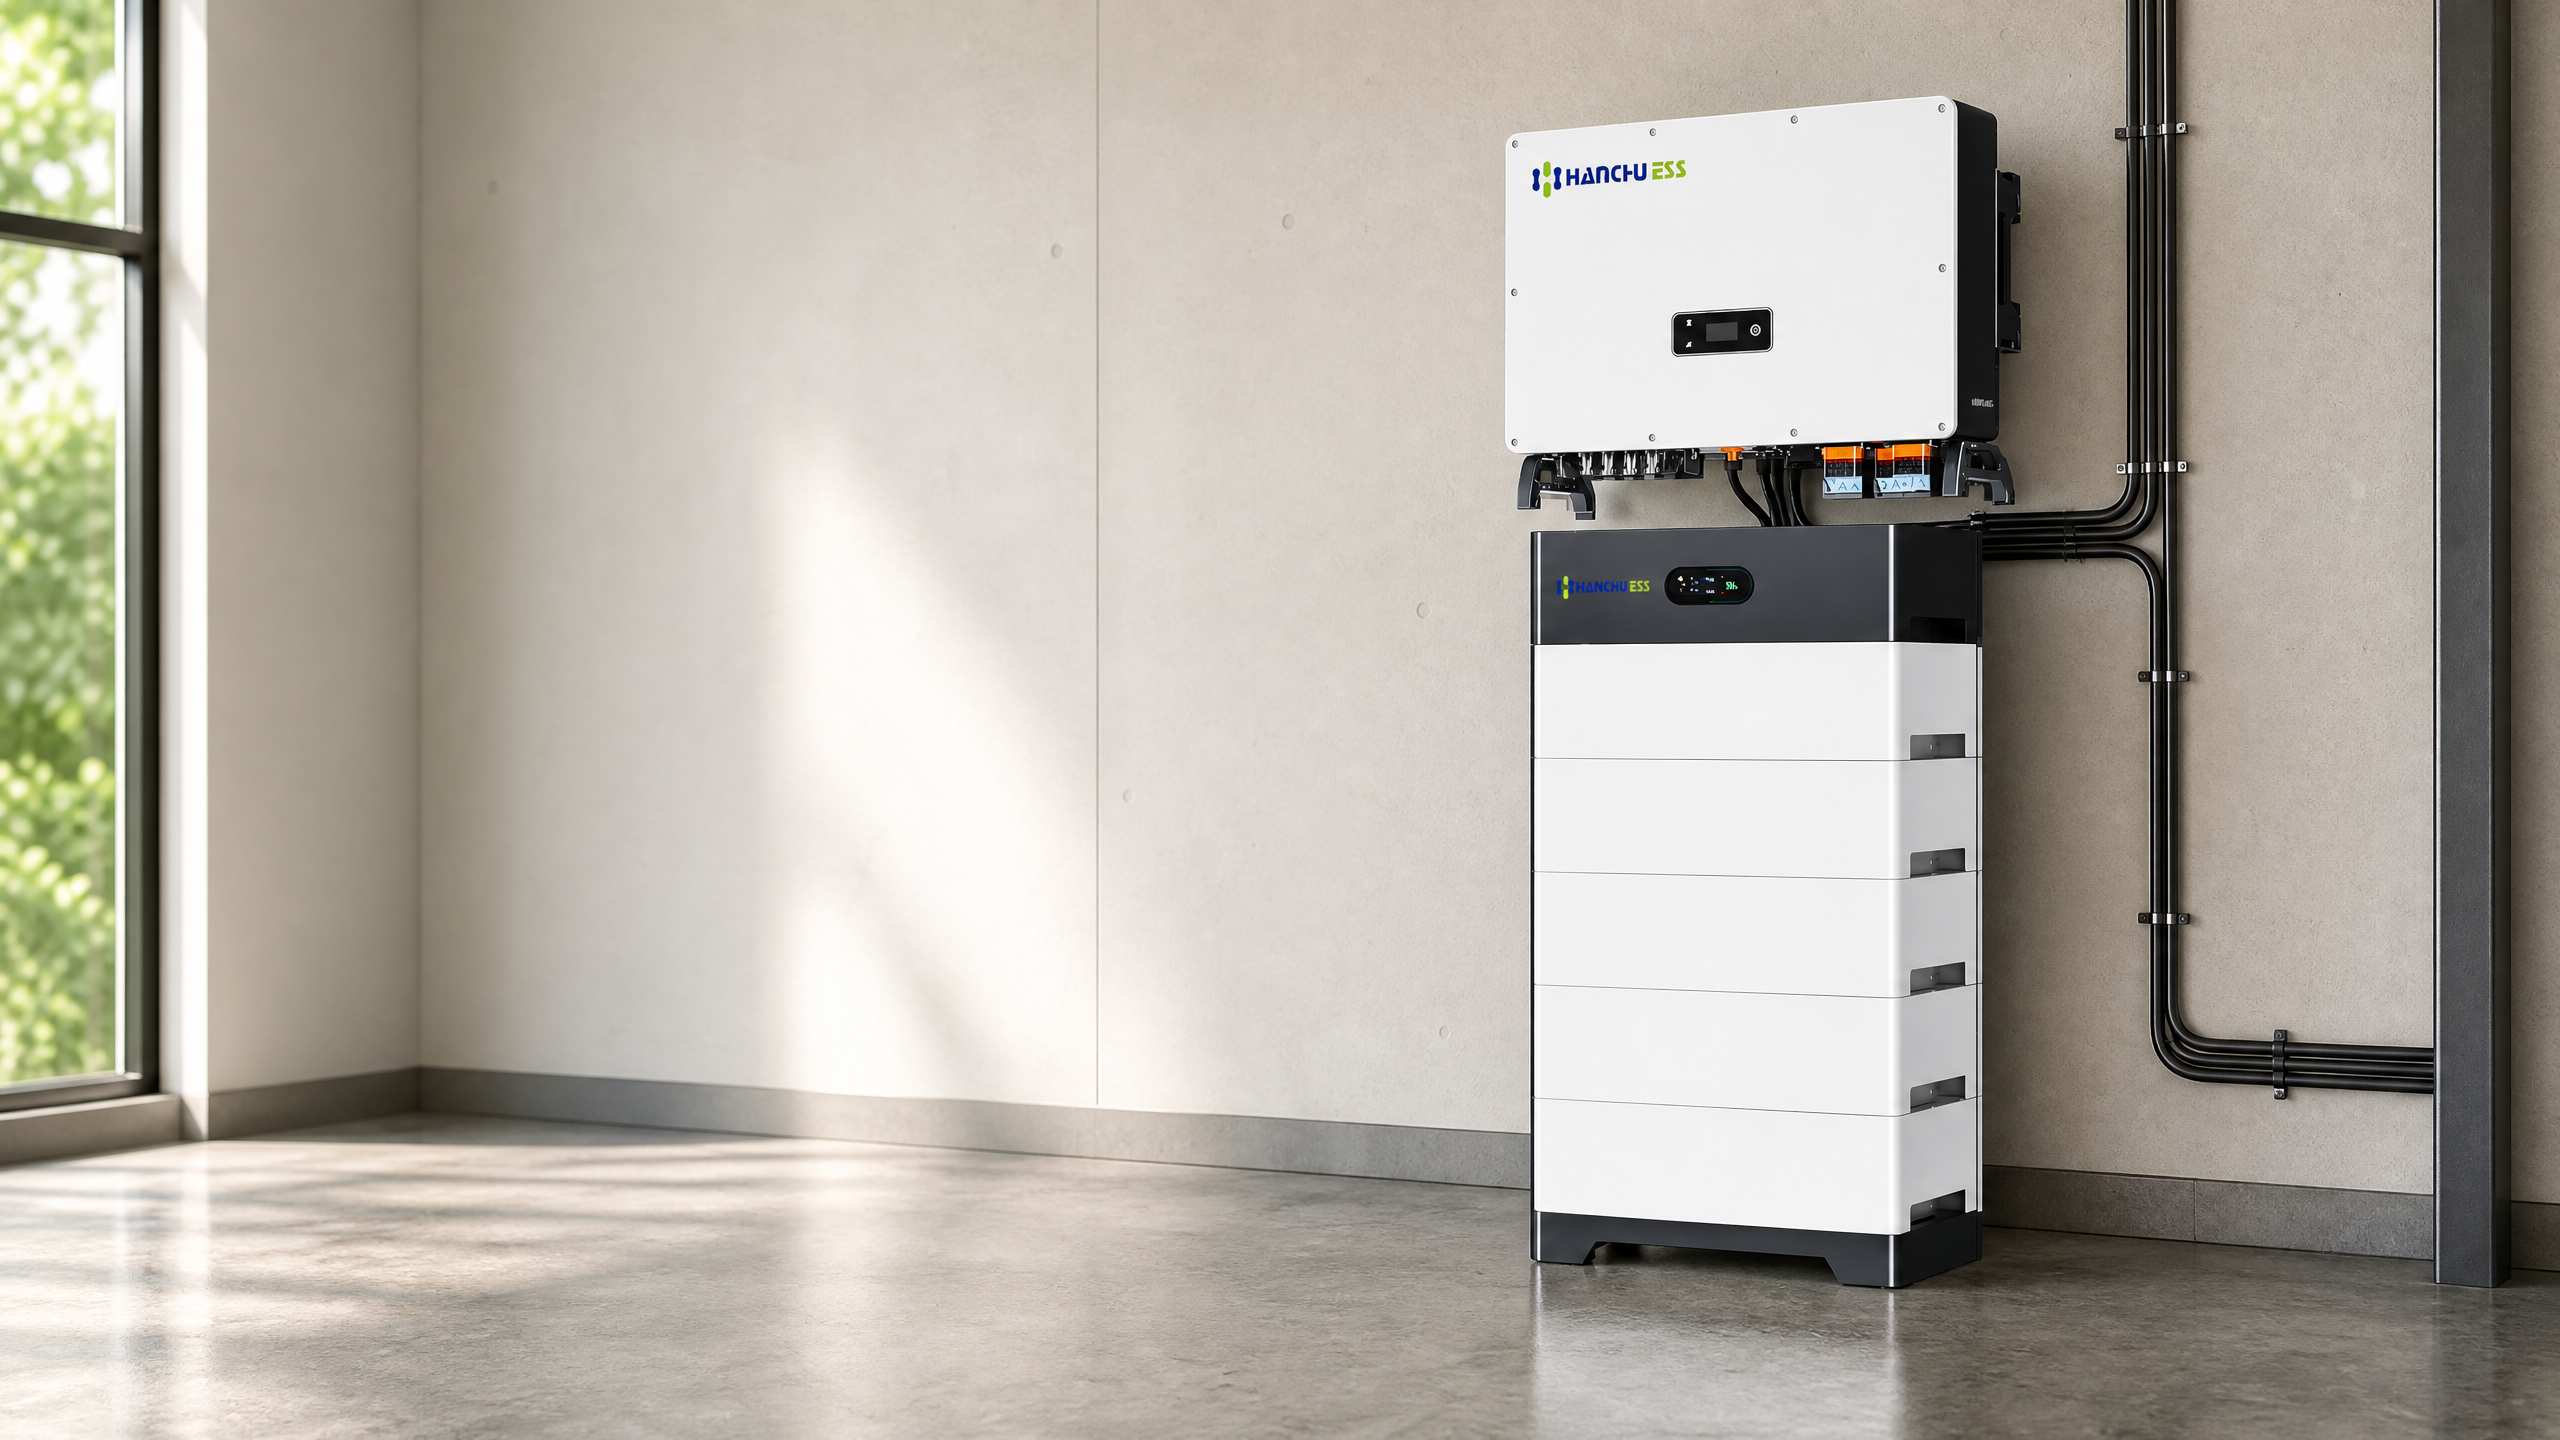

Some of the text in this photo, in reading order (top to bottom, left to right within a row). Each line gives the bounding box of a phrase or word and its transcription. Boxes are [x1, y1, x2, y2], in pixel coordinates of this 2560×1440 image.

[1565, 159, 1687, 187] HANCHU ESS
[1575, 580, 1650, 594] HANCHU ESS
